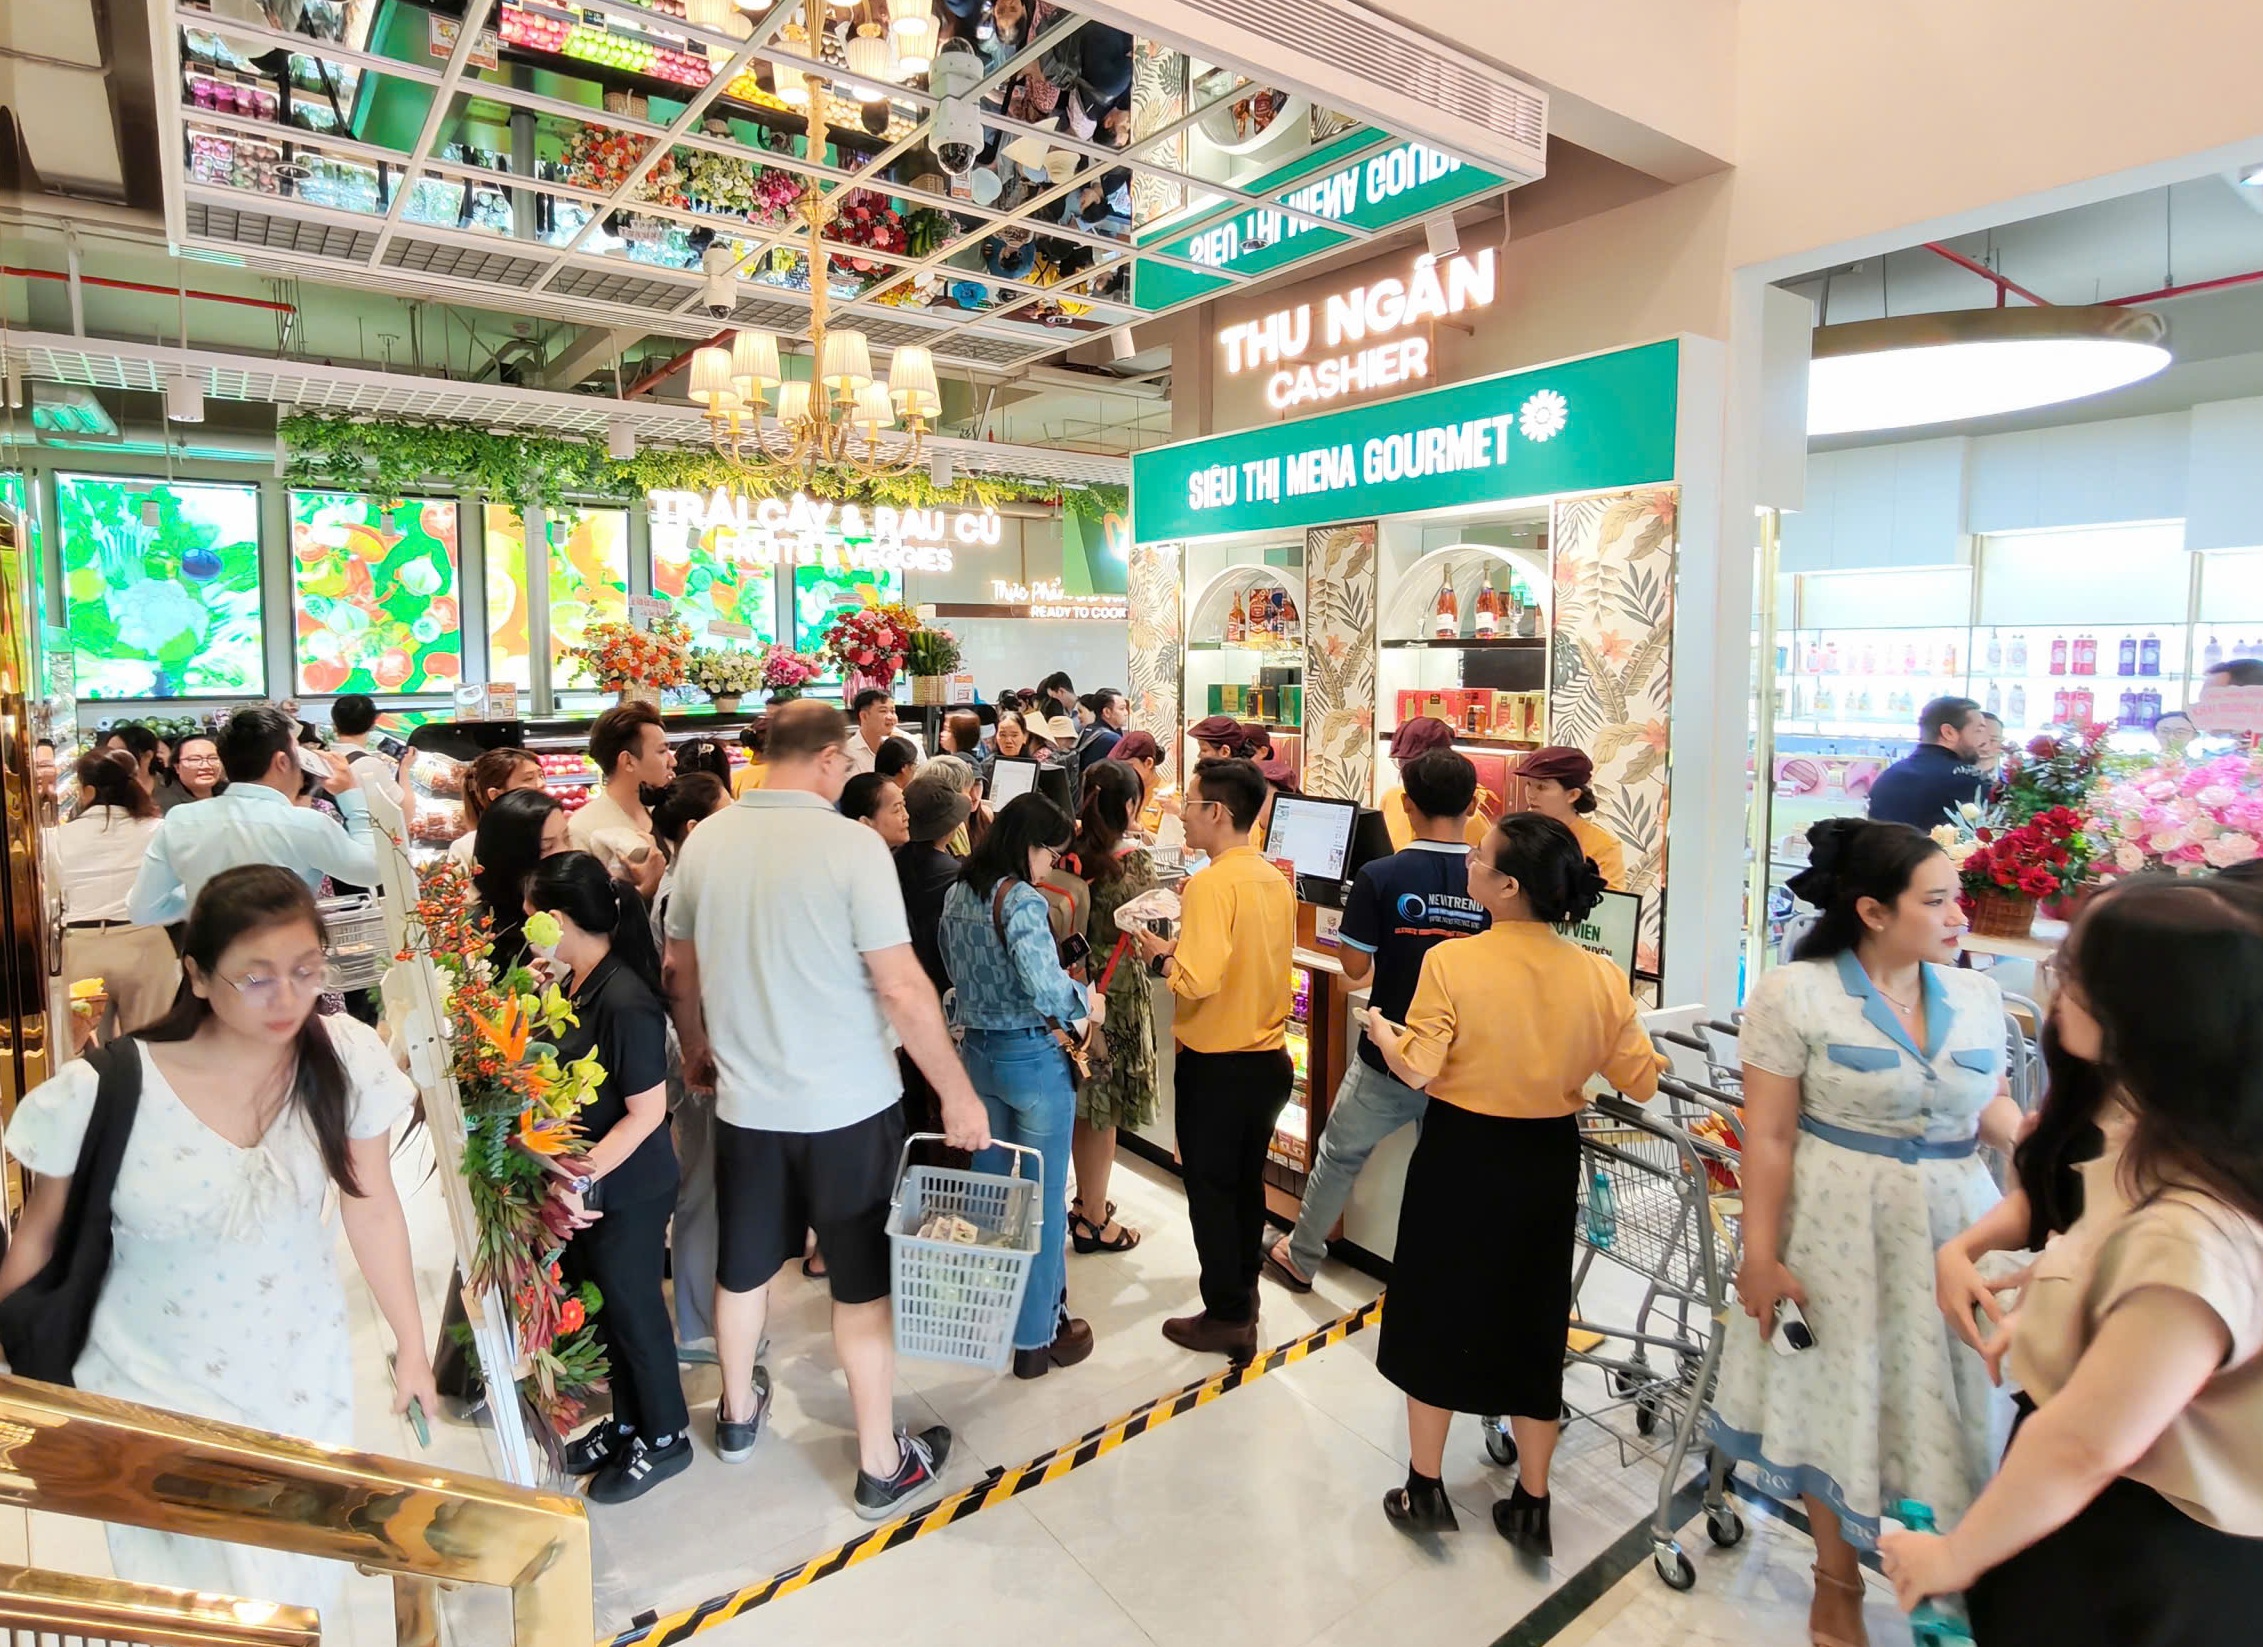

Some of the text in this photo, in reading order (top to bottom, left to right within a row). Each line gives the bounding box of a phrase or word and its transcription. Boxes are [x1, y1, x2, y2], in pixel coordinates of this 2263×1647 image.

[1220, 247, 1495, 374] THU NGÂN
[1266, 337, 1429, 409] CASHIER
[1188, 413, 1514, 510] SIÊU THỊ MENA GOURMET
[757, 492, 833, 532] CÂY
[840, 504, 865, 536] &
[874, 505, 946, 541] RAU
[954, 506, 1001, 545] CỦ
[845, 545, 953, 572] VEGGIES
[1030, 605, 1128, 619] READY TO COOK
[1428, 893, 1484, 913] NEWTREND
